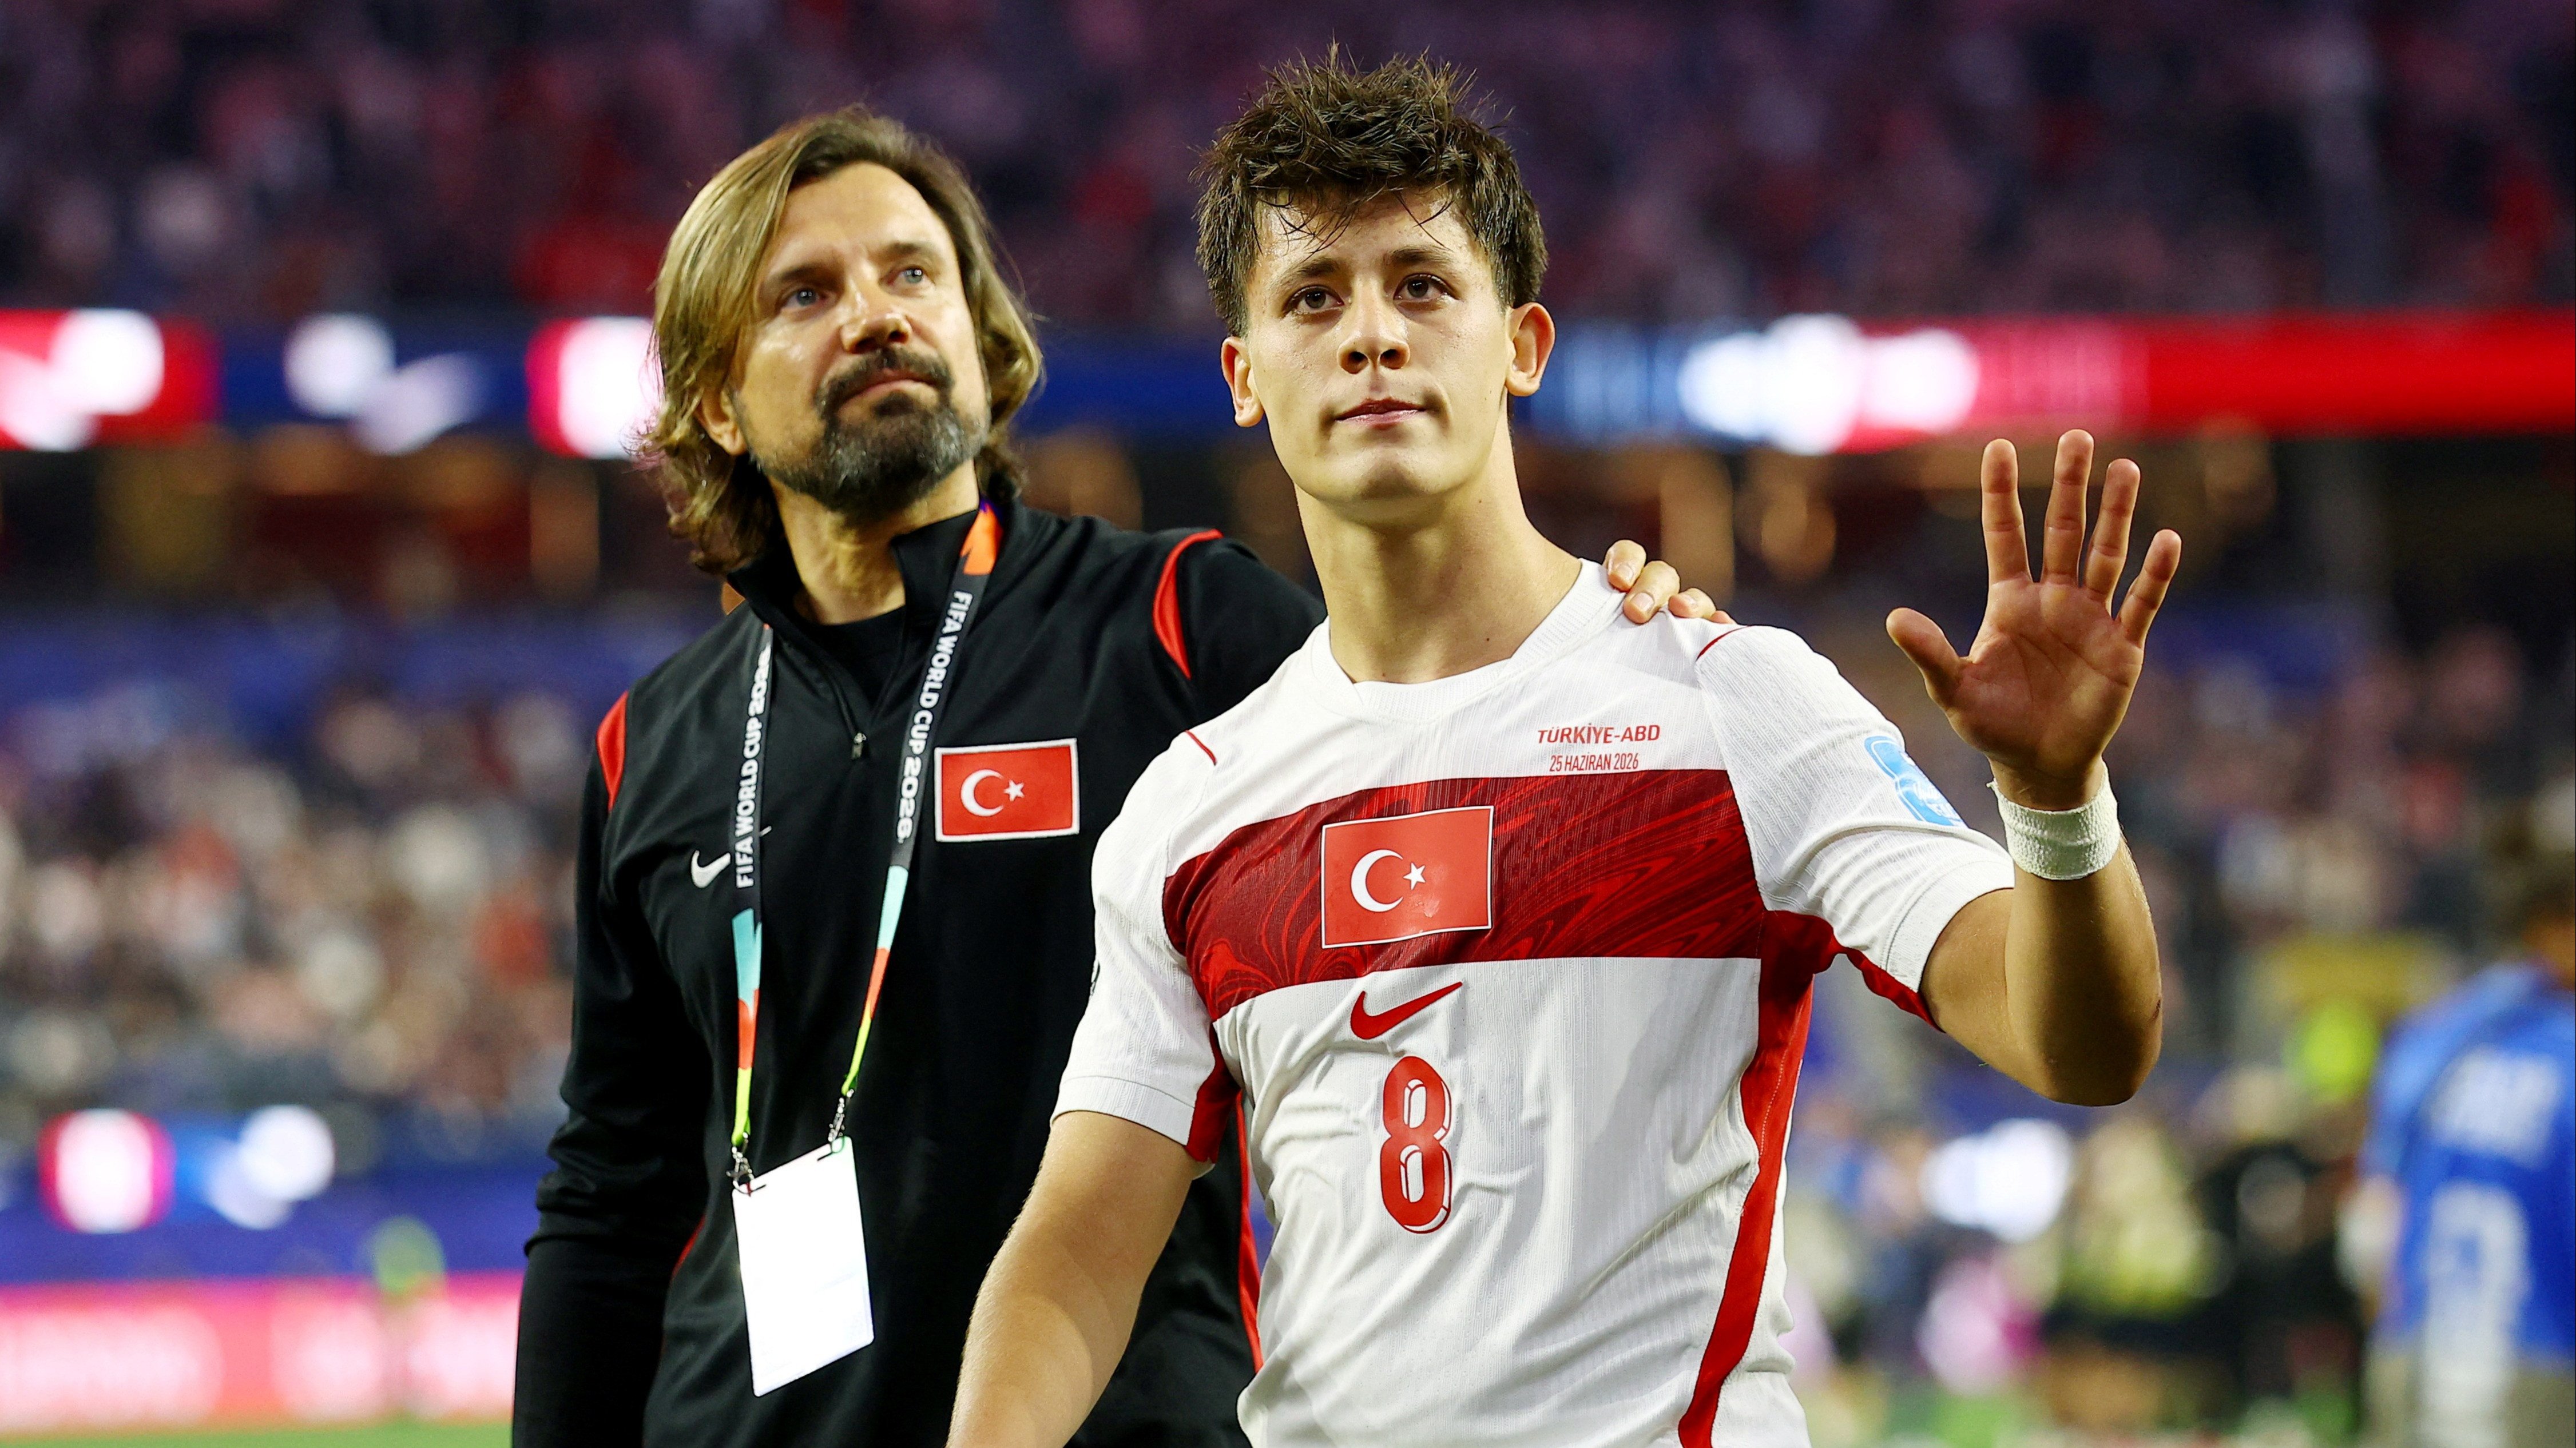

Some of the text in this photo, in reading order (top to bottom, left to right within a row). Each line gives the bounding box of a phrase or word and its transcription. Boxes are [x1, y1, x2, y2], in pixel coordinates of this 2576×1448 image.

[743, 717, 763, 759] CUP
[897, 590, 973, 843] FIFA WORLD CUP 2026
[1538, 723, 1661, 744] TÜRKİYE-ABD
[1549, 751, 1639, 771] 25 HAZİRAN 2026
[735, 758, 759, 837] WORLD
[735, 836, 754, 888] FIFA
[1380, 1056, 1452, 1234] 8
